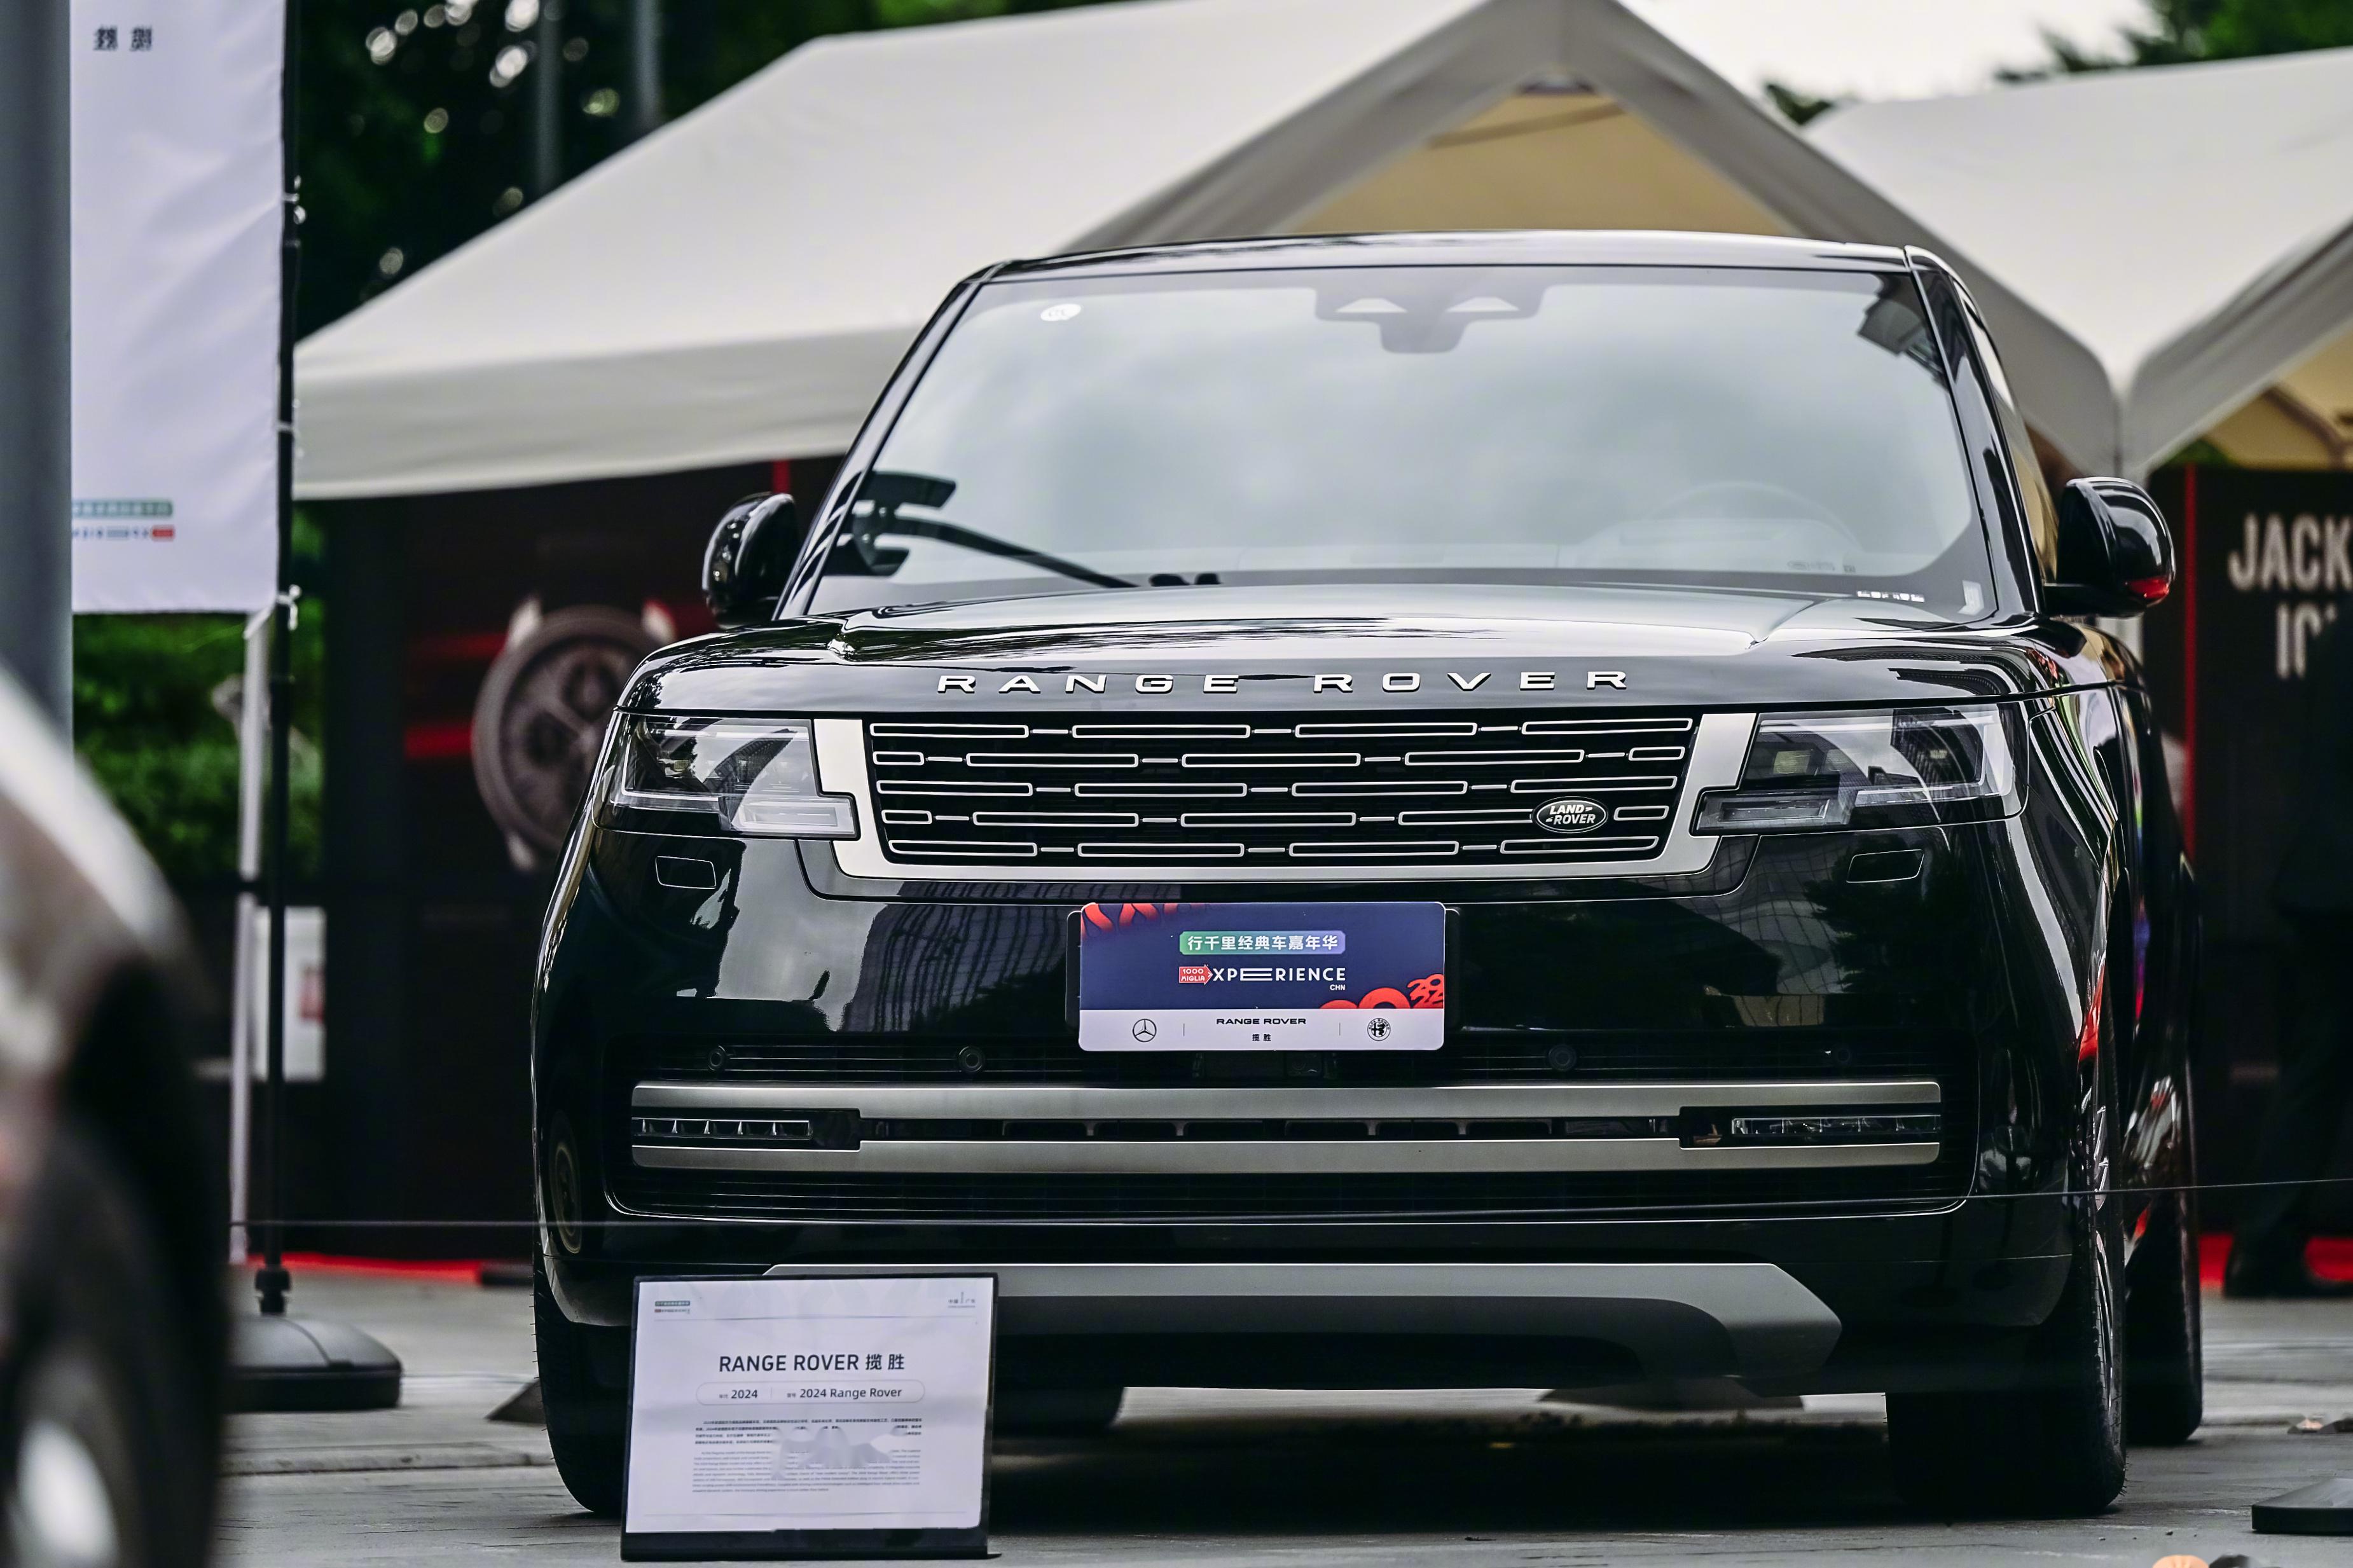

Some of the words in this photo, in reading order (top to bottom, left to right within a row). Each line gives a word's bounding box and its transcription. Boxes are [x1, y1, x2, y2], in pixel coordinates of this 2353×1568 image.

[937, 675, 1239, 694] RANGE
[1313, 671, 1627, 693] ROVER
[1549, 804, 1585, 815] LAND
[1553, 814, 1596, 825] ROVER
[1188, 935, 1338, 951] 行千里经典车嘉年华
[719, 1355, 787, 1372] RANGE
[794, 1354, 859, 1370] ROVER
[866, 1354, 904, 1370] 揽胜
[731, 1389, 758, 1398] 2024
[800, 1389, 827, 1398] 2024
[831, 1388, 866, 1400] Range
[870, 1387, 902, 1397] Rover
